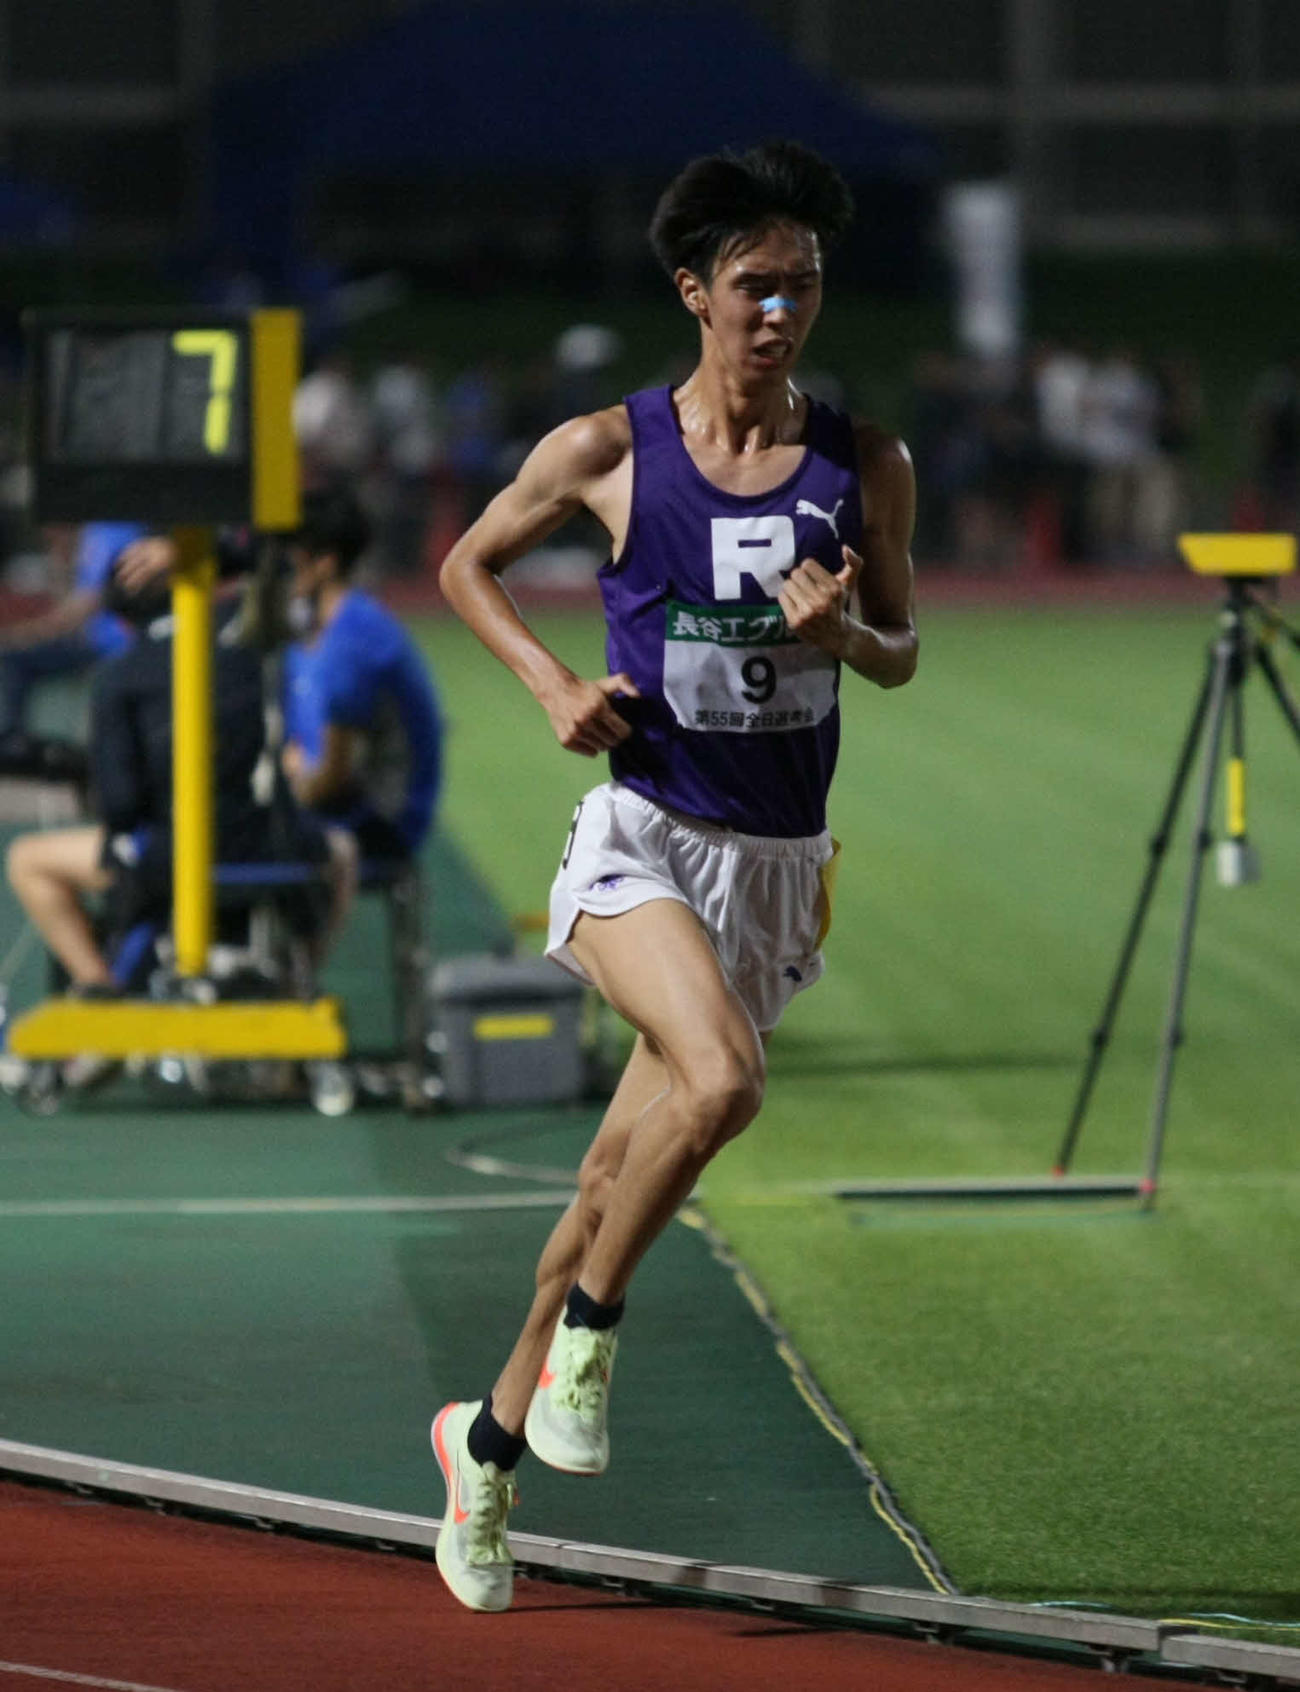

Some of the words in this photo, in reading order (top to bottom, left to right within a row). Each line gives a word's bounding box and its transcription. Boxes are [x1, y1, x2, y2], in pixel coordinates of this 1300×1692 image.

[172, 329, 238, 453] 7
[711, 515, 796, 600] R
[741, 656, 776, 704] 9
